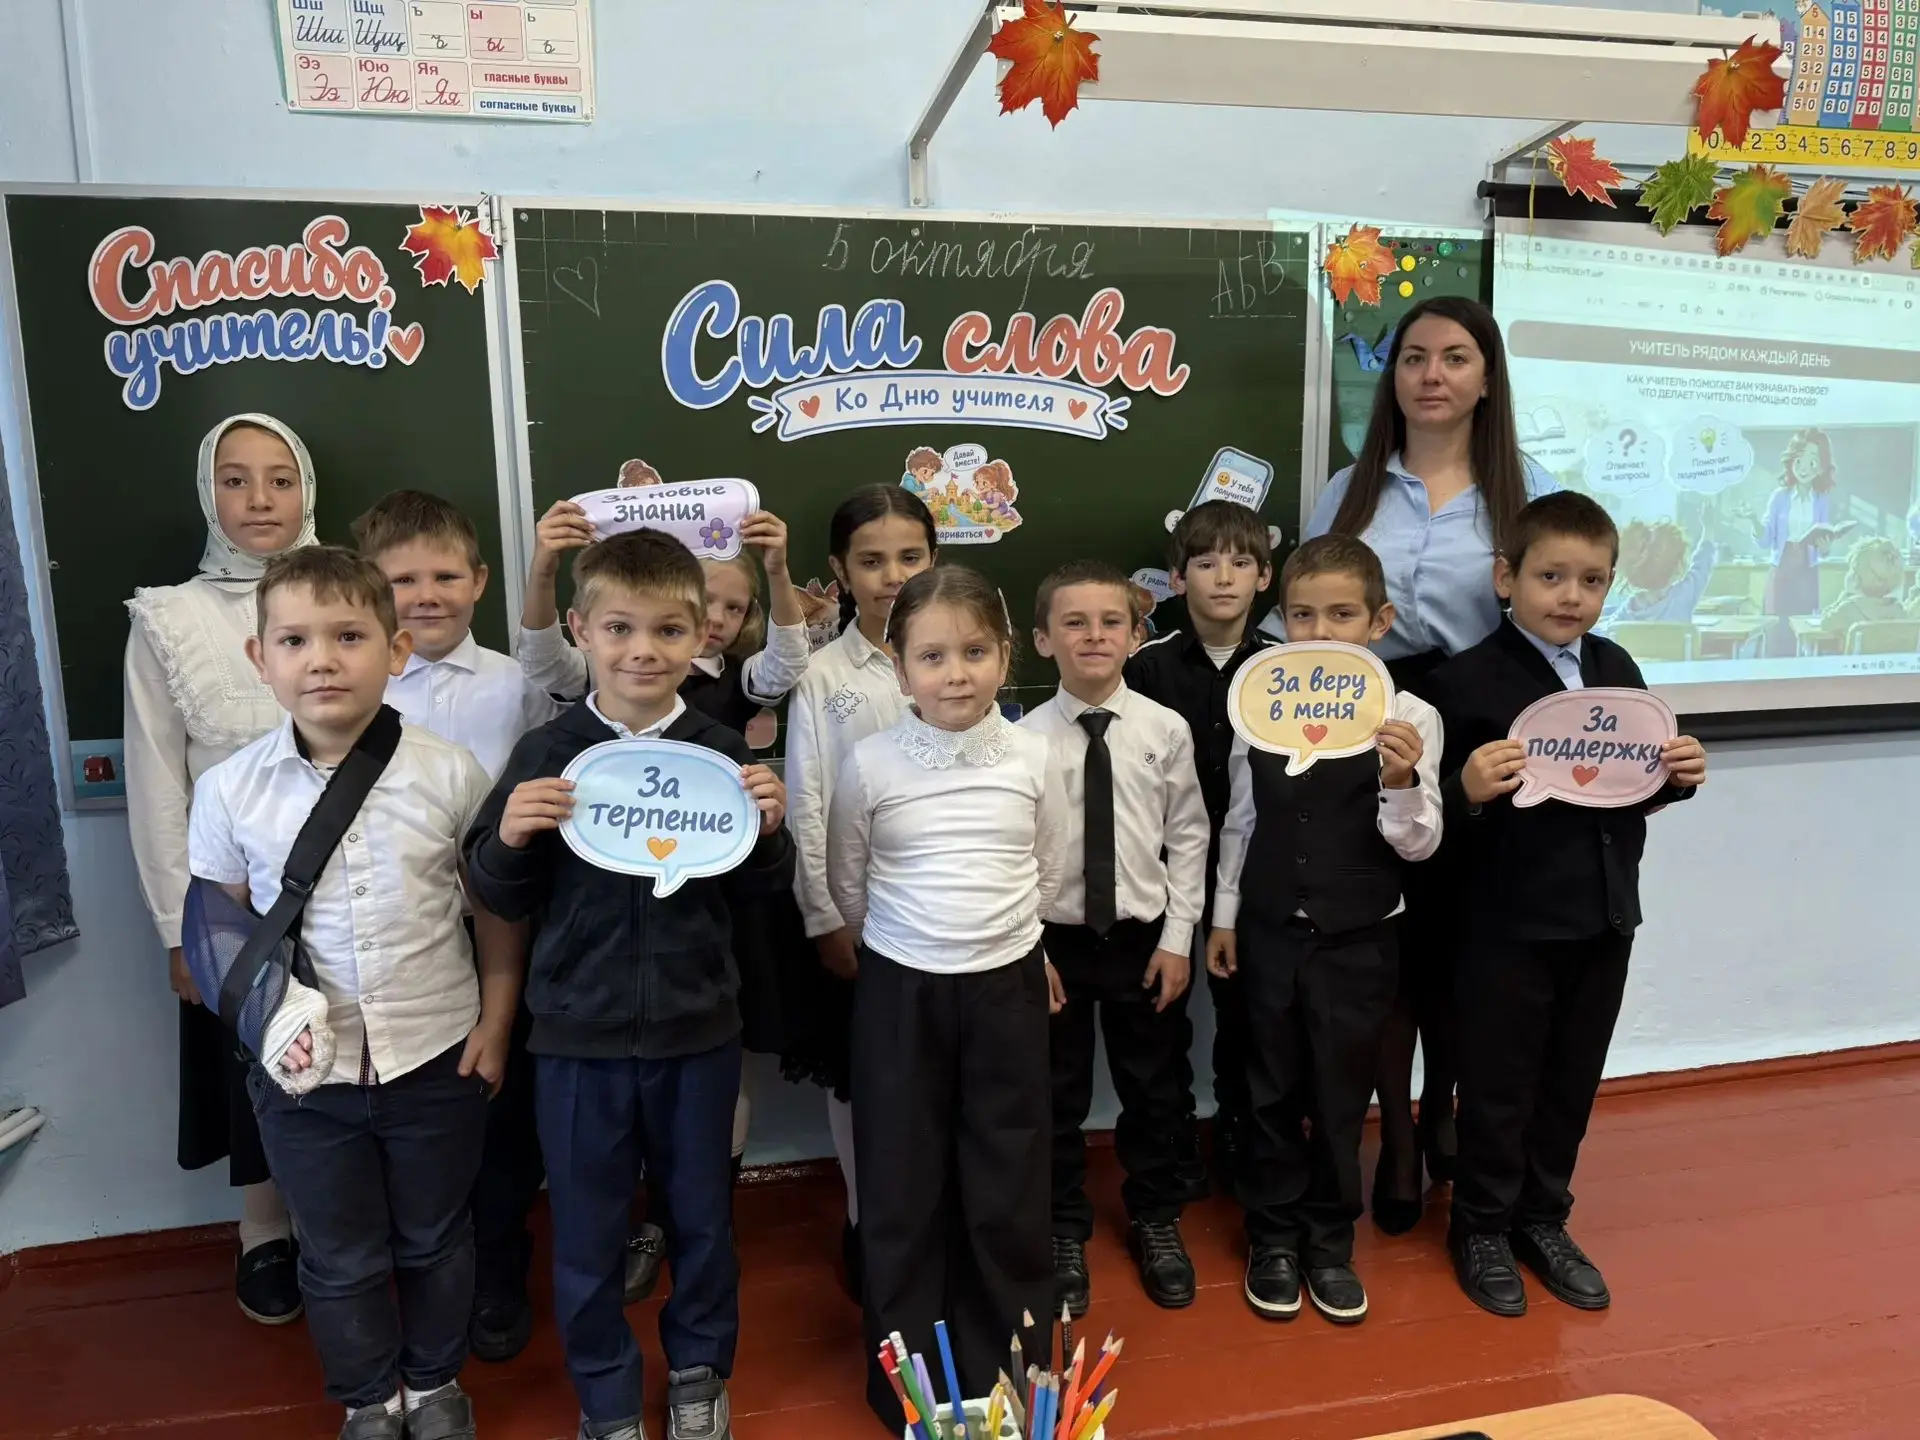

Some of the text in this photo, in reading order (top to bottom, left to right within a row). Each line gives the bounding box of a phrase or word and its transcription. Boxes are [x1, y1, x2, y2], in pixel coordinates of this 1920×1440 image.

[298, 56, 321, 70] Ээ
[358, 59, 389, 73] Юю
[417, 62, 439, 76] Яя
[310, 73, 341, 102] Ээ
[360, 76, 410, 103] Юю
[424, 78, 461, 106] Яя
[483, 72, 568, 86] гласные буквы
[479, 99, 577, 114] согласные буквы
[1751, 133, 1763, 151] 2
[1775, 133, 1787, 151] 3
[1798, 135, 1808, 152] 4
[1819, 137, 1829, 154] 5
[1840, 138, 1851, 156] 6
[1863, 140, 1874, 157] 7
[1885, 141, 1896, 159] 8
[1907, 142, 1918, 160] 9
[90, 216, 395, 324] Спасибо,
[1211, 239, 1285, 314] АБВ
[107, 309, 392, 409] учитель!
[663, 281, 1190, 409] Сила слова
[1628, 339, 1831, 368] УЧИТЕЛЬ РЯДОМ КАЖДЫЙ ДЕНЬ
[835, 384, 1054, 414] Ко Дню учителя
[601, 485, 726, 503] За новые
[1238, 481, 1255, 494] тебя
[1266, 665, 1367, 700] За веру
[1269, 699, 1355, 721] в меня
[1582, 705, 1618, 733] За
[1527, 737, 1664, 774] поддержку
[637, 766, 681, 799] За
[588, 803, 734, 839] терпение
